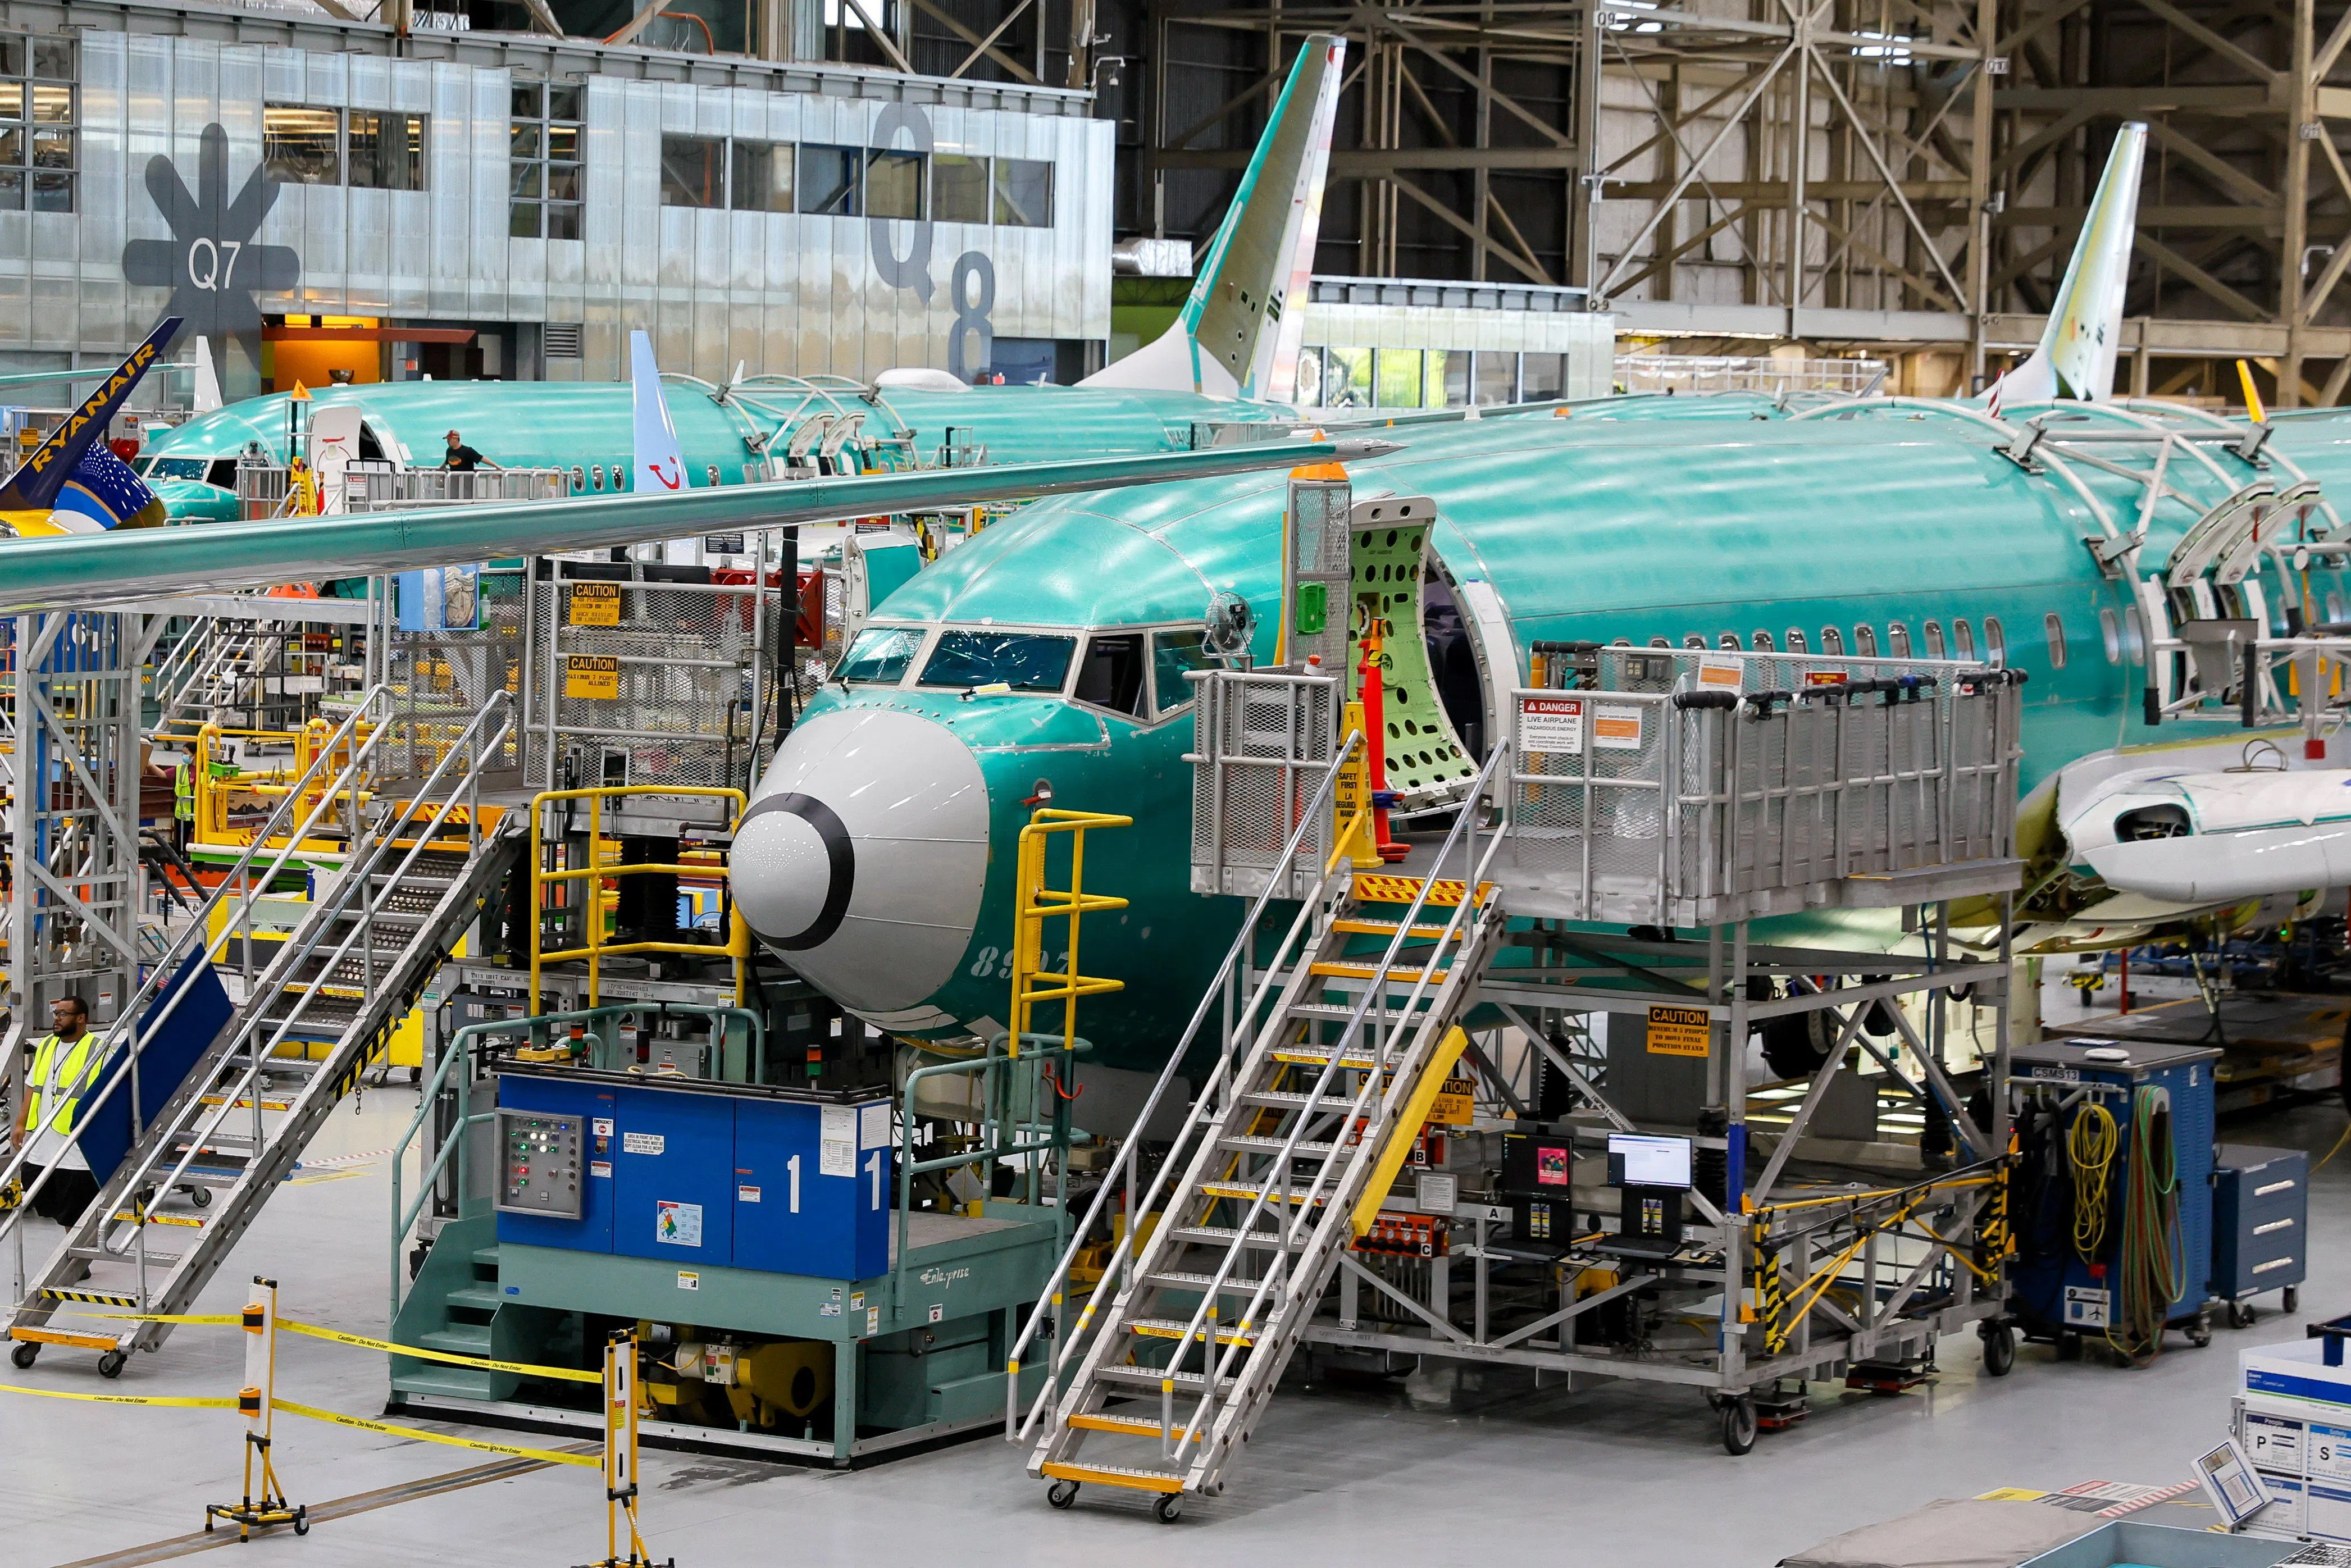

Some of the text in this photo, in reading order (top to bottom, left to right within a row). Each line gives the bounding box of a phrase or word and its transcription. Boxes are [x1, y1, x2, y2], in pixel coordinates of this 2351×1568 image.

[189, 237, 242, 293] Q7
[33, 344, 156, 473] RYANAIR
[576, 585, 616, 596] CAUTION
[571, 658, 614, 671] CAUTION
[1539, 702, 1577, 712] DANGER
[1652, 1009, 1705, 1025] CAUTION
[2034, 1068, 2079, 1080] CSMS13
[1416, 1151, 1424, 1162] B
[787, 1155, 800, 1214] 1
[864, 1150, 880, 1211] 1
[1489, 1207, 1499, 1219] A
[1421, 1245, 1430, 1255] C
[338, 1334, 356, 1343] Caution
[336, 1416, 355, 1425] Caution
[2257, 1435, 2266, 1450] P
[2320, 1446, 2330, 1461] S
